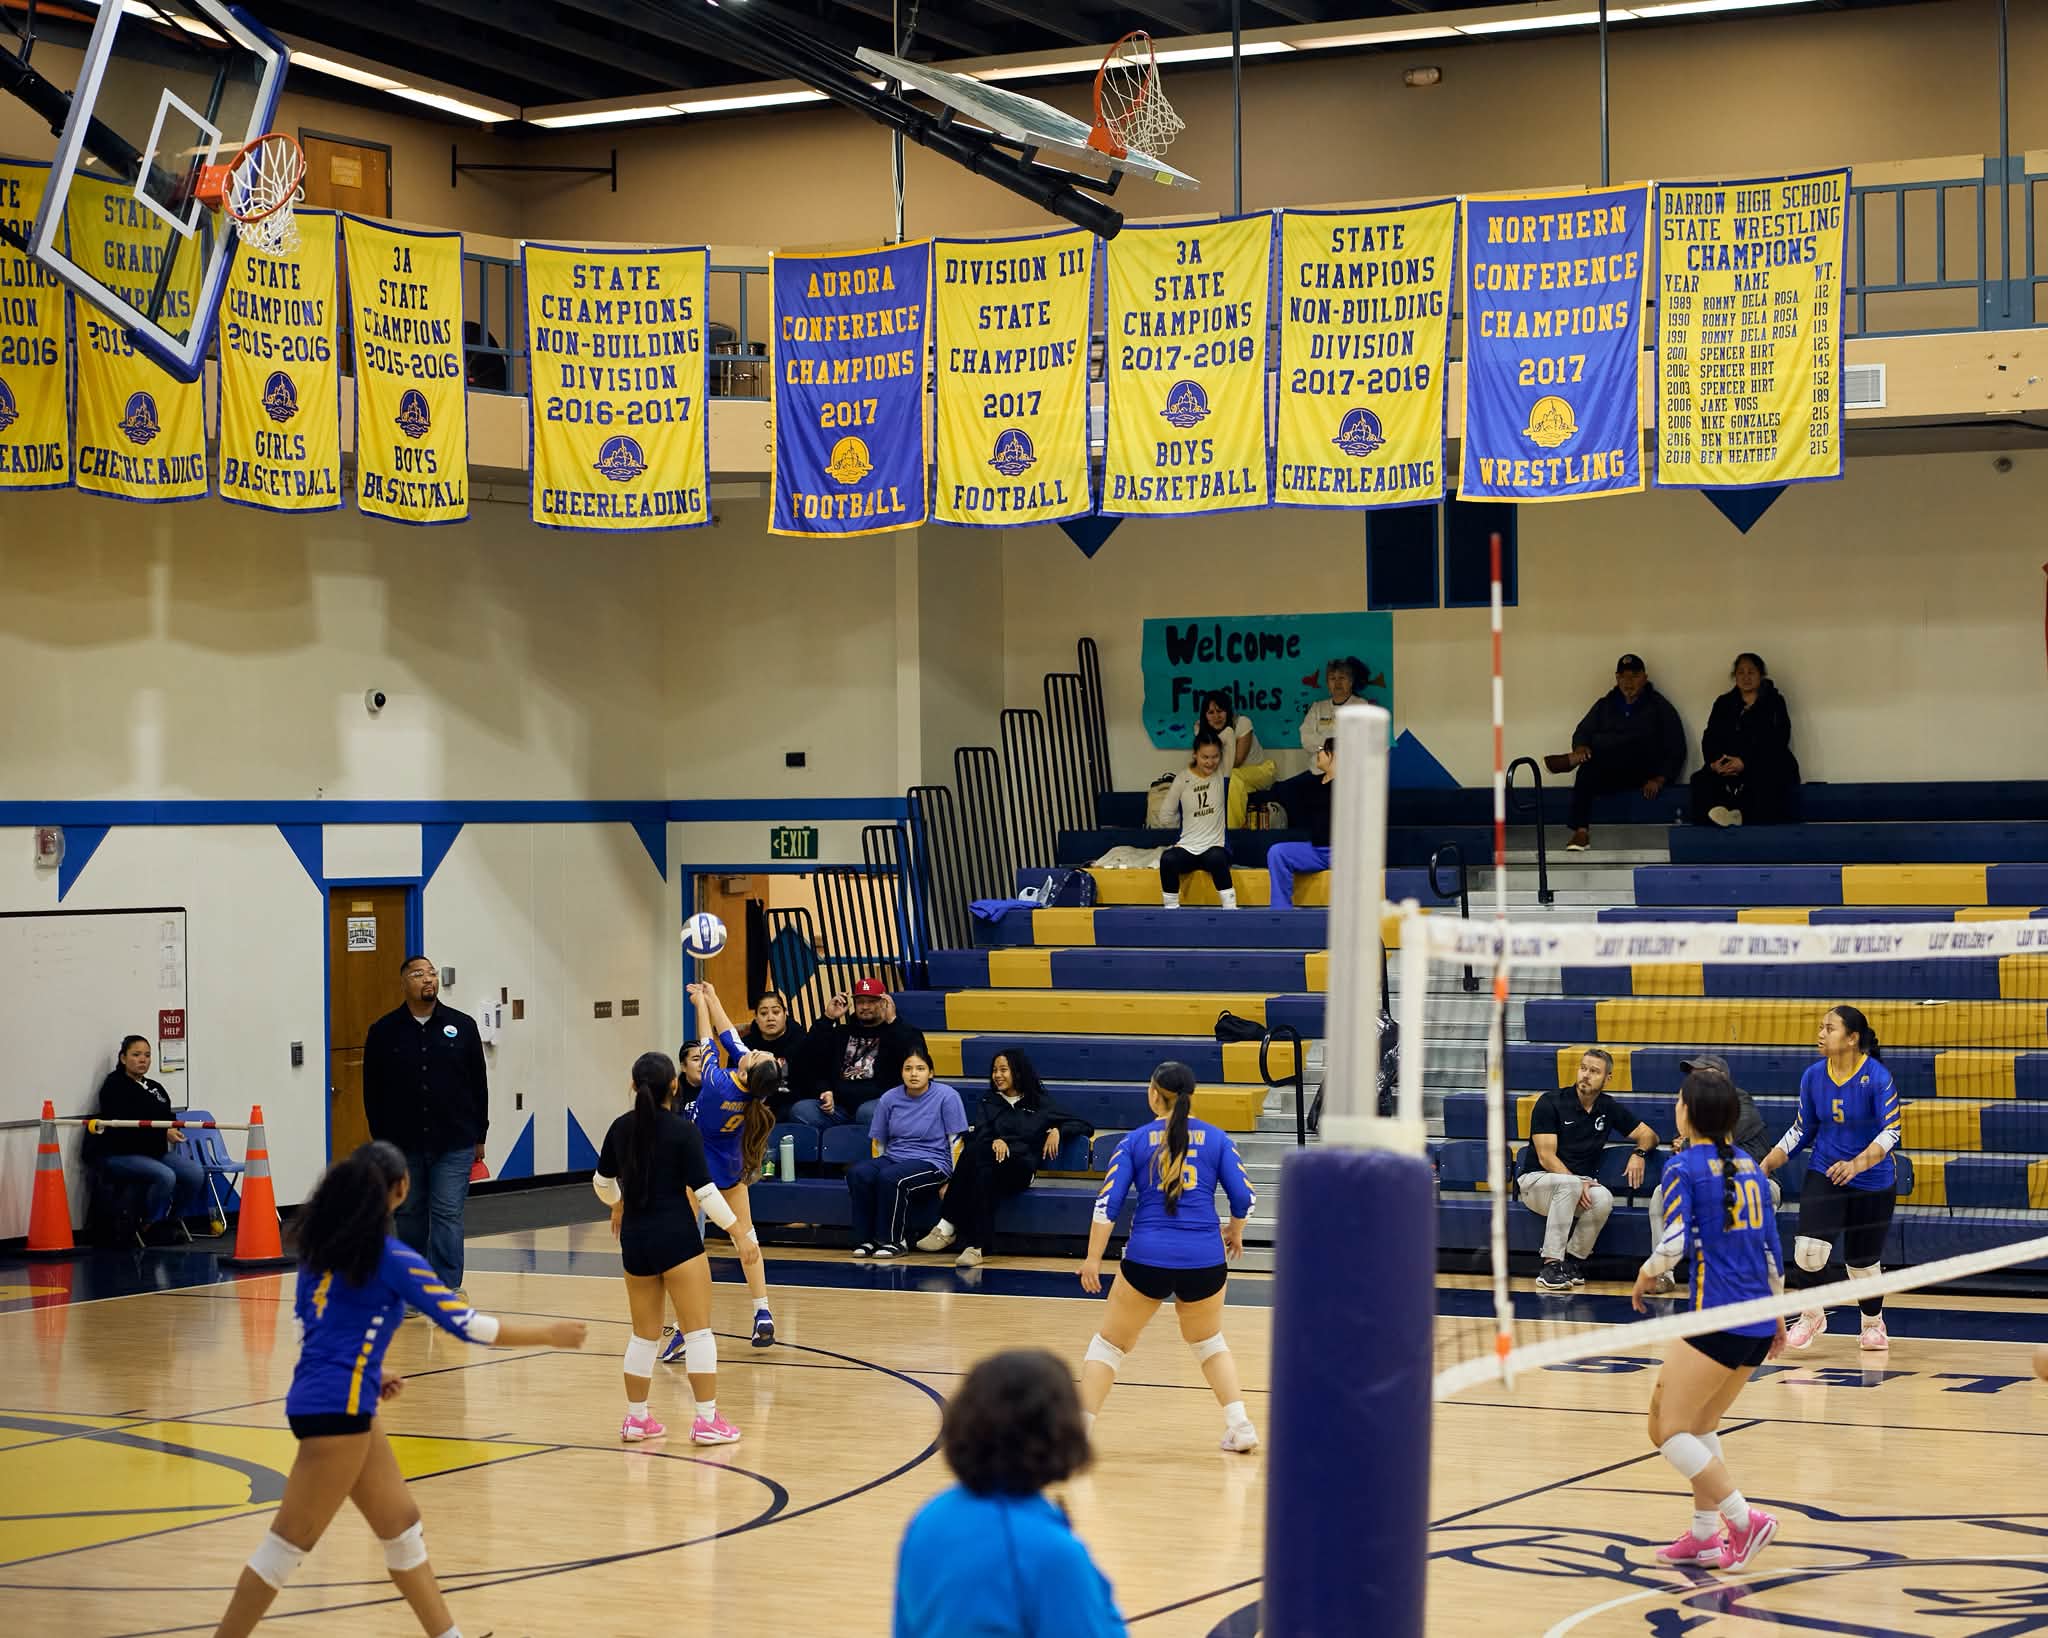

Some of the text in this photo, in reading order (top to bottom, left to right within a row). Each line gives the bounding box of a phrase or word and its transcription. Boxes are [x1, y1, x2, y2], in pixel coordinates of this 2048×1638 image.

[1665, 180, 1841, 215] BARROW HIGH SCHOOL
[1332, 224, 1405, 253] STATE
[1488, 206, 1627, 243] NORTHERN
[1664, 206, 1840, 241] STATE WRESTLING
[104, 240, 164, 274] GRAND
[393, 246, 412, 274] 3A
[944, 248, 1085, 285] DIVISION III
[1176, 239, 1202, 265] 3A
[1687, 235, 1817, 271] CHAMPIONS
[248, 257, 300, 289] STATE
[573, 264, 660, 291] STATE
[807, 265, 895, 298] AURORA
[1154, 271, 1225, 302] STATE
[1300, 256, 1435, 289] CHAMPIONS
[1474, 251, 1638, 291] CONFERENCE
[1665, 274, 1699, 293] YEAR
[1734, 271, 1769, 292] NAME
[230, 288, 324, 326] CHAMPIONS
[379, 278, 428, 310] STATE
[541, 294, 692, 325] CHAMPIONS
[1290, 290, 1444, 325] NON-BUILDING
[1669, 296, 1692, 310] 1989
[1742, 292, 1767, 308] DELA
[1774, 289, 1799, 306] ROSA
[1814, 284, 1829, 299] 112
[783, 305, 920, 342] CONFERENCE
[978, 300, 1051, 331] STATE
[1124, 301, 1252, 337] CHAMPIONS
[1480, 301, 1628, 337] CHAMPIONS
[1668, 313, 1690, 327] 1990
[1741, 310, 1767, 325] DELA
[1773, 307, 1798, 323] ROSA
[1813, 302, 1828, 316] 119
[227, 322, 331, 362] 2015-2016
[536, 327, 699, 358] NON-BUILDING
[1310, 330, 1415, 360] DIVISION
[1667, 330, 1687, 344] 1991
[1740, 327, 1767, 342] DELA
[1772, 324, 1797, 340] ROSA
[1813, 319, 1828, 333] 119
[2, 336, 57, 366] 2016
[363, 342, 460, 379] 2015-2016
[949, 338, 1077, 375] CHAMPIONS
[1121, 336, 1255, 371] 2017-2018
[1667, 337, 1829, 361] 2001 SPENCER HIRT 125
[561, 364, 677, 391] DIVISION
[787, 350, 914, 385] CHAMPIONS
[1291, 364, 1430, 395] 2017-2018
[1518, 354, 1586, 386] 2017
[1667, 354, 1829, 379] 2002 SPENCER HIRT 145
[1667, 371, 1829, 396] 2003 SPENCER HIRT 152
[547, 396, 691, 425] 2016-2017
[820, 398, 878, 428] 2017
[983, 390, 1042, 418] 2017
[1667, 388, 1829, 413] 2006 JAKE VOSS 189
[1668, 415, 1691, 429] 2006
[1731, 412, 1781, 428] GONZALES
[1812, 406, 1829, 421] 215
[255, 430, 306, 461] GIRLS
[1667, 423, 1829, 447] 2016 BEN HEATHER 220
[394, 445, 438, 474] BOYS
[1156, 439, 1214, 467] BOYS
[1479, 449, 1625, 487] WRESTLING
[1665, 441, 1828, 464] 2018 BEN HEATHER 215
[1113, 467, 1257, 501] BASKETBALL
[1282, 460, 1435, 493] CHEERLEADING
[542, 488, 701, 518] CHEERLEADING
[792, 486, 906, 520] FOOTBALL
[953, 479, 1068, 512] FOOTBALL
[1166, 624, 1300, 667] Welcome
[1198, 791, 1209, 809] 12
[781, 830, 810, 857] EXIT
[163, 1015, 181, 1024] NEED
[164, 1026, 181, 1036] HELP
[1832, 1098, 1845, 1123] 5
[1727, 1179, 1764, 1230] 20
